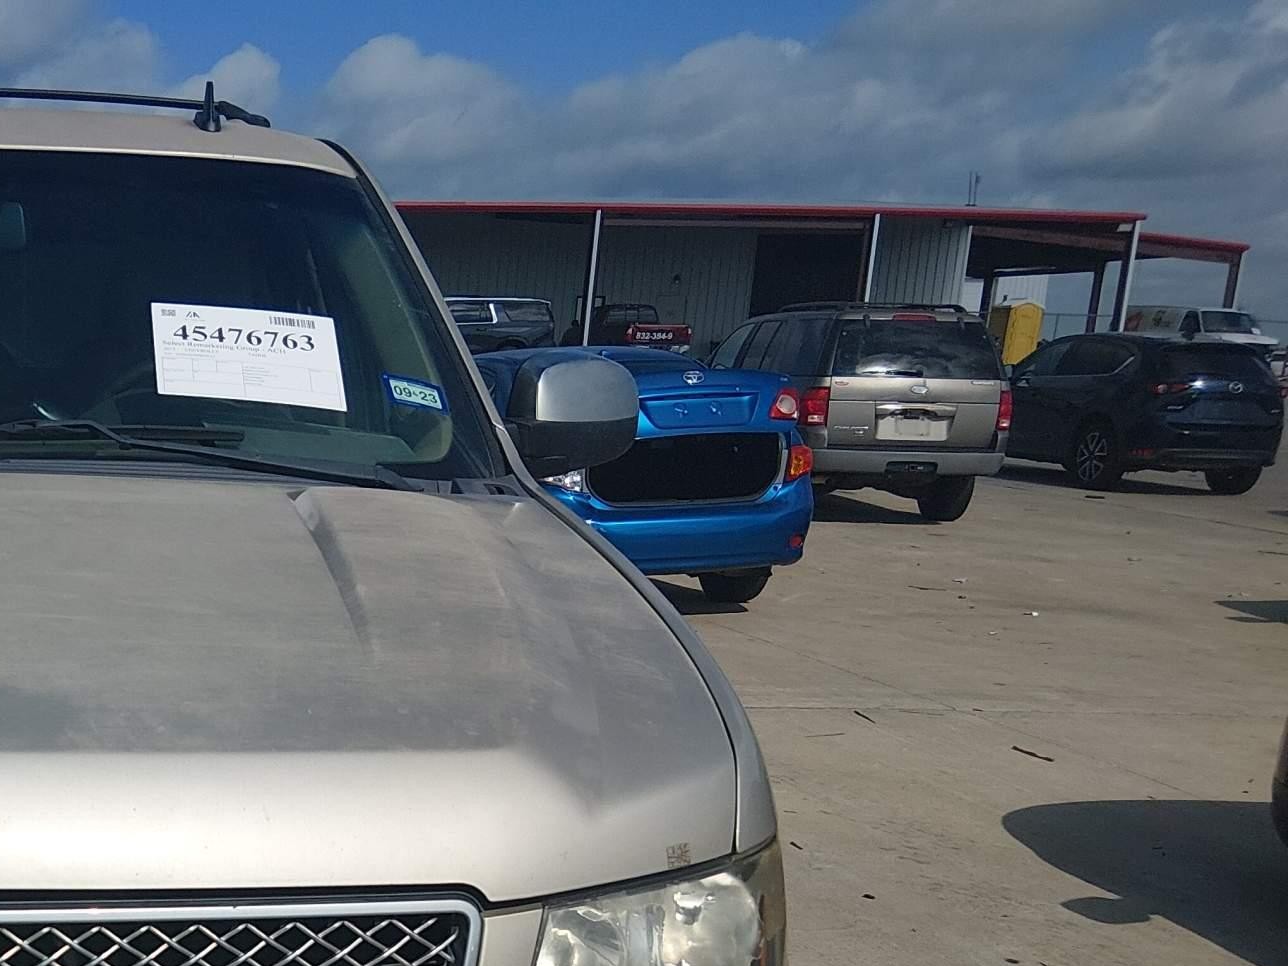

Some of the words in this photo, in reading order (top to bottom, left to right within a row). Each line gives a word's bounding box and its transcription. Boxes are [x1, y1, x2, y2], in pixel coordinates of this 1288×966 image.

[173, 324, 315, 352] 45476763
[393, 385, 412, 397] 09
[419, 391, 438, 404] 23
